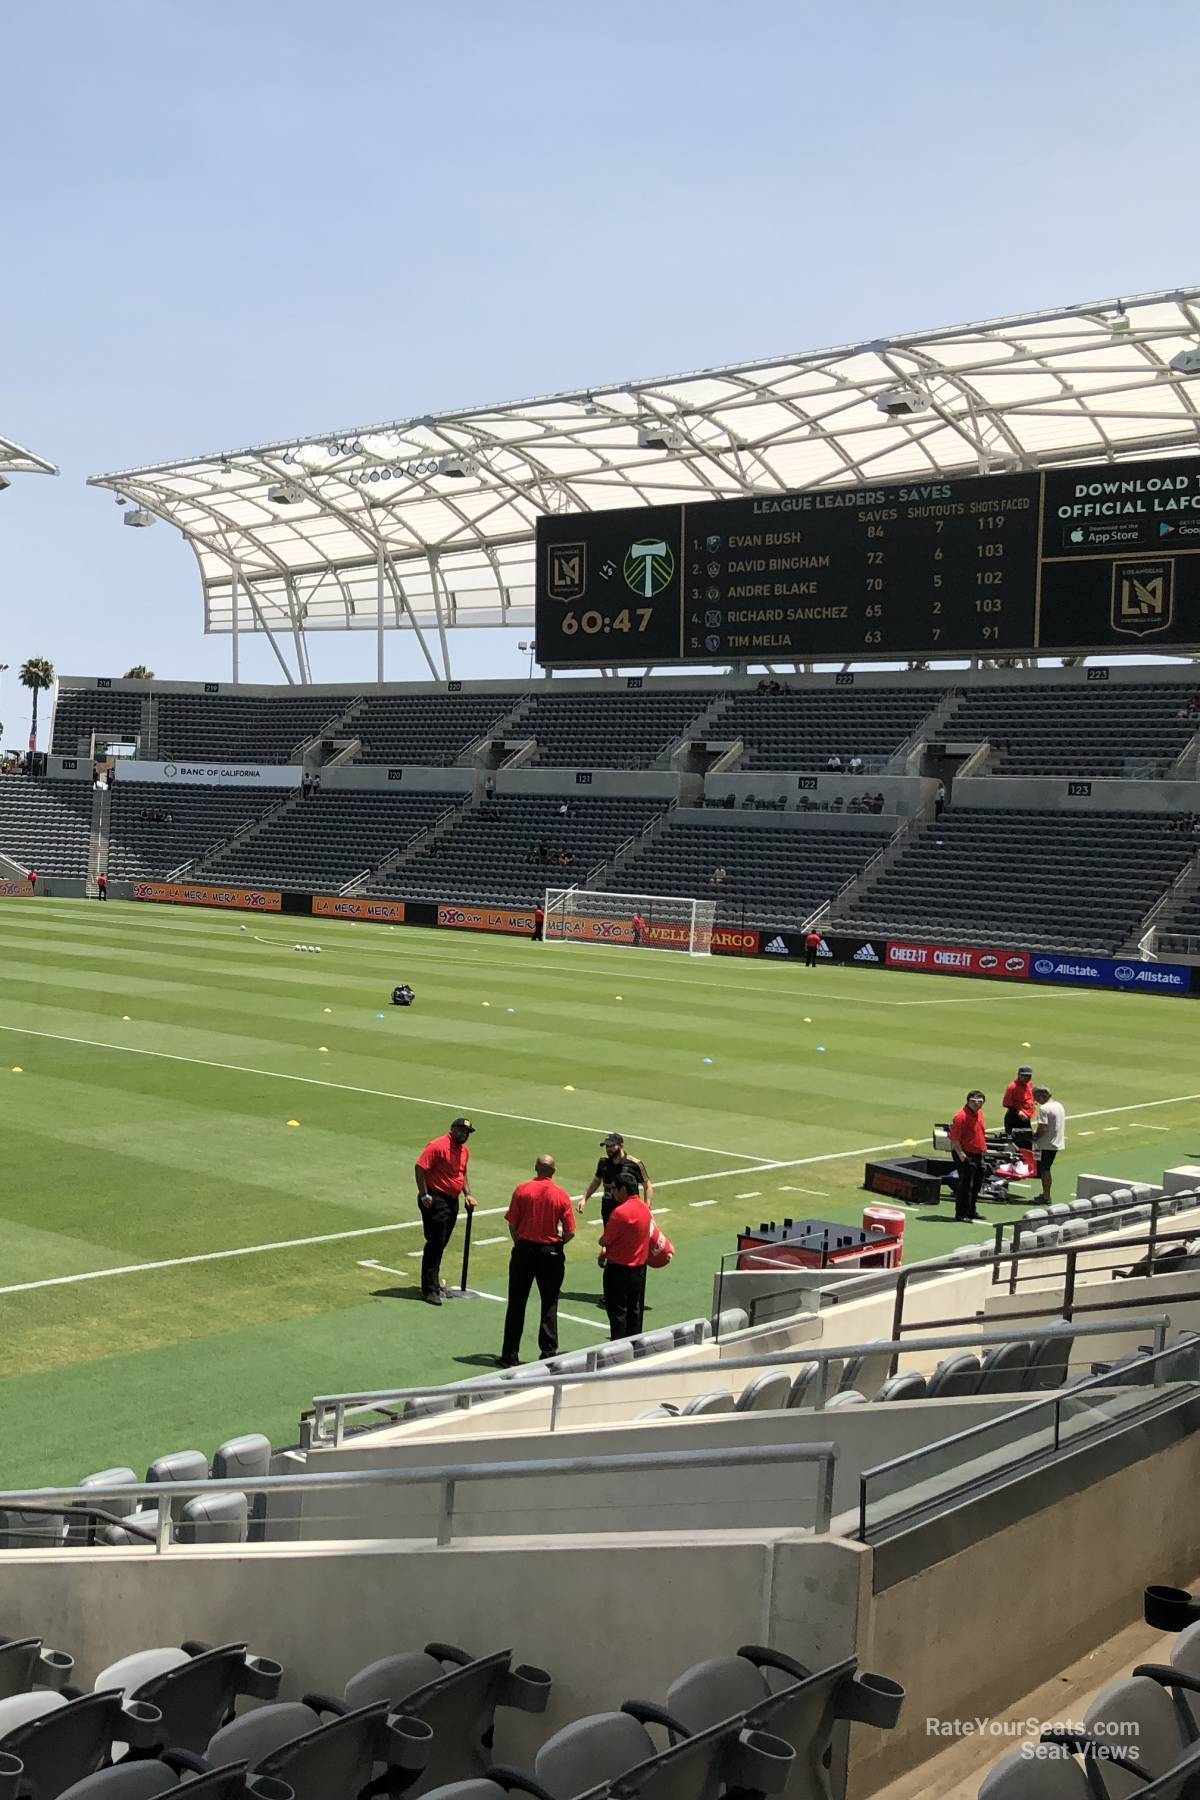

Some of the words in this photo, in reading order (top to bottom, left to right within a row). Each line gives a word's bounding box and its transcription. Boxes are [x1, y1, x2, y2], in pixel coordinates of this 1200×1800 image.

[1075, 476, 1188, 497] DOWNLOAD
[753, 497, 812, 514] LEAGUE
[816, 490, 885, 509] LEADERS
[900, 485, 951, 502] SAVES
[858, 509, 898, 522] SAVES
[907, 503, 965, 518] SHUTOUTS
[970, 501, 999, 513] SHOTS
[1001, 498, 1030, 511] FACED
[1058, 502, 1146, 518] OFFICIAL
[728, 534, 762, 548] EVAN
[765, 532, 801, 545] BUSH
[867, 526, 884, 538] 84
[935, 521, 944, 533] 7
[978, 516, 1005, 529] 119
[1088, 533, 1110, 543] App
[1111, 531, 1138, 540] Store
[728, 560, 766, 573] DAVID
[769, 556, 830, 571] BINGHAM
[867, 552, 883, 565] 72
[934, 548, 943, 560] 6
[977, 544, 1004, 557] 103
[727, 584, 771, 598] ANDRE
[774, 582, 817, 595] BLAKE
[866, 578, 883, 590] 70
[933, 575, 942, 587] 5
[976, 572, 1002, 584] 102
[727, 609, 784, 622] RICHARD
[786, 606, 848, 620] SANCHEZ
[865, 605, 882, 617] 65
[933, 602, 941, 614] 2
[975, 599, 1002, 612] 103
[561, 608, 653, 635] 60:47
[727, 636, 750, 647] TIM
[752, 634, 792, 647] MELIA
[864, 631, 881, 643] 63
[932, 628, 941, 641] 7
[982, 626, 999, 639] 91
[1089, 670, 1108, 679] 223
[180, 768, 205, 776] BANC
[800, 780, 816, 789] 122
[1071, 784, 1090, 794] 123
[169, 888, 180, 897] LA
[184, 891, 208, 899] MERA
[316, 901, 329, 911] LA
[334, 903, 362, 914] MERA
[367, 905, 400, 917] MERA!
[488, 914, 502, 925] LA
[509, 918, 536, 929] MER
[704, 930, 755, 948] FARGO
[764, 945, 789, 954] adidas
[853, 951, 879, 962] adidas
